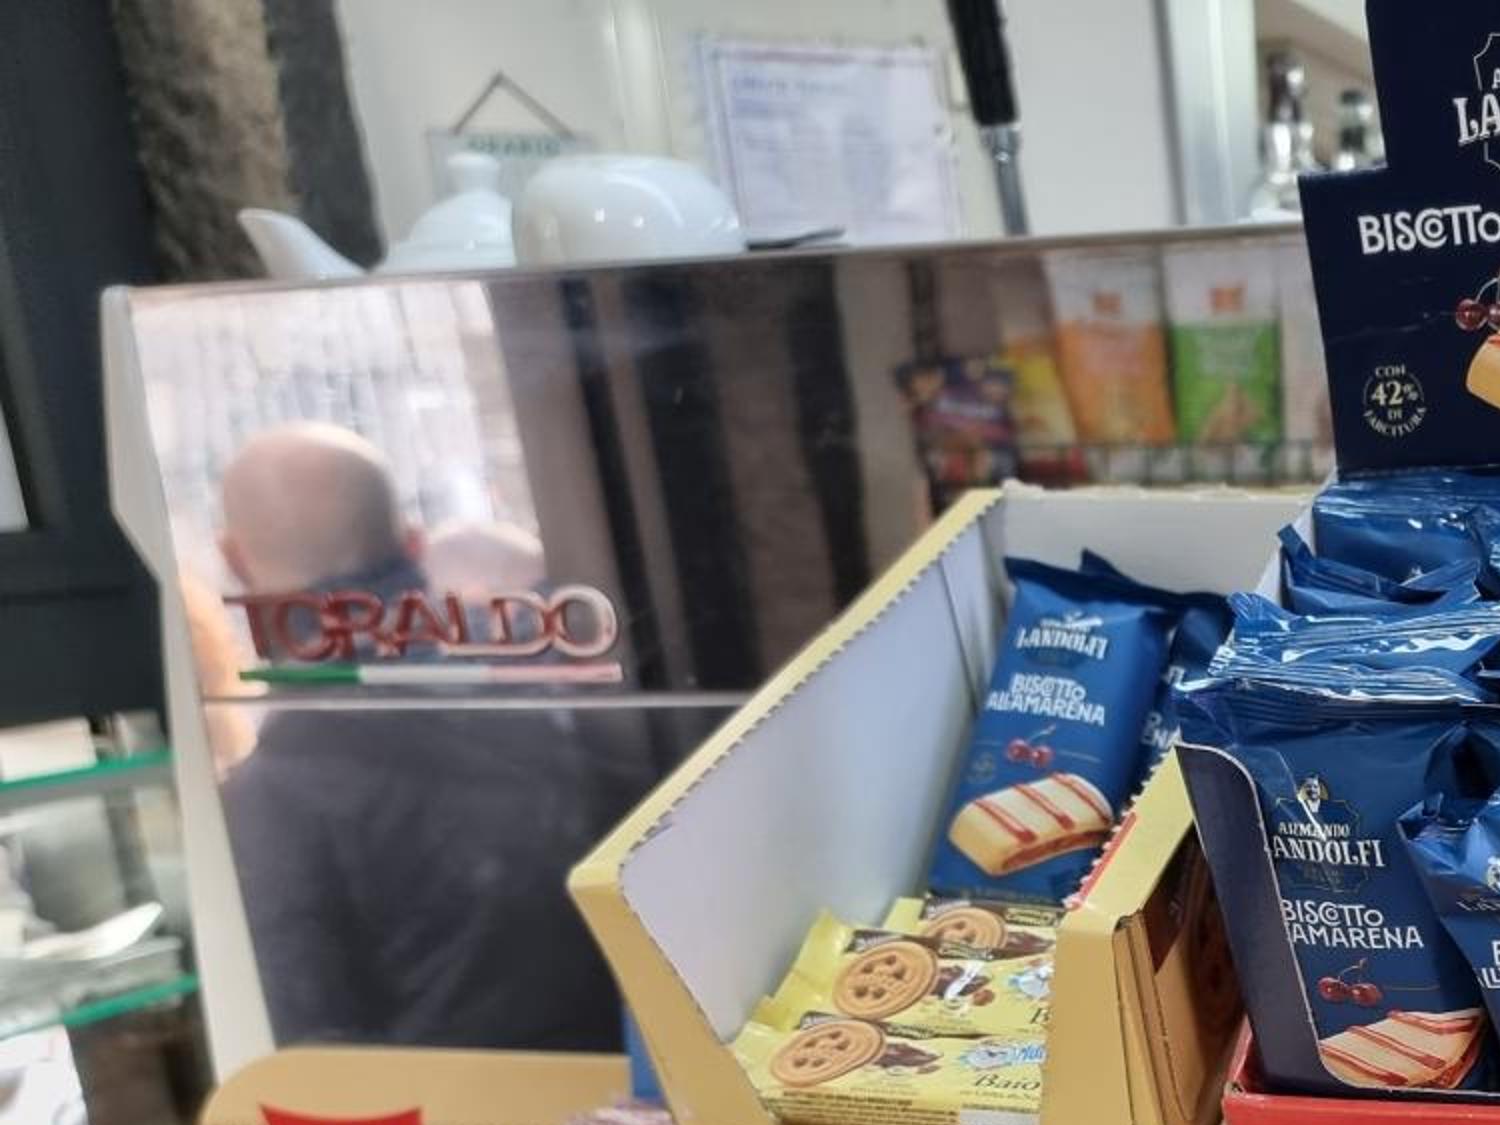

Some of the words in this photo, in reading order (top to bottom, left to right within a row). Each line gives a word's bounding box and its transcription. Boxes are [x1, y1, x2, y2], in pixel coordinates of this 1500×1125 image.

[1375, 365, 1406, 378] CON
[224, 586, 620, 662] TORALDO
[1016, 627, 1109, 661] LANDOLFI
[1010, 673, 1086, 701] BISCOTTO
[1279, 822, 1350, 837] ARMANDO
[1273, 835, 1386, 867] ANDOLFI
[974, 1074, 1040, 1091] Baio
